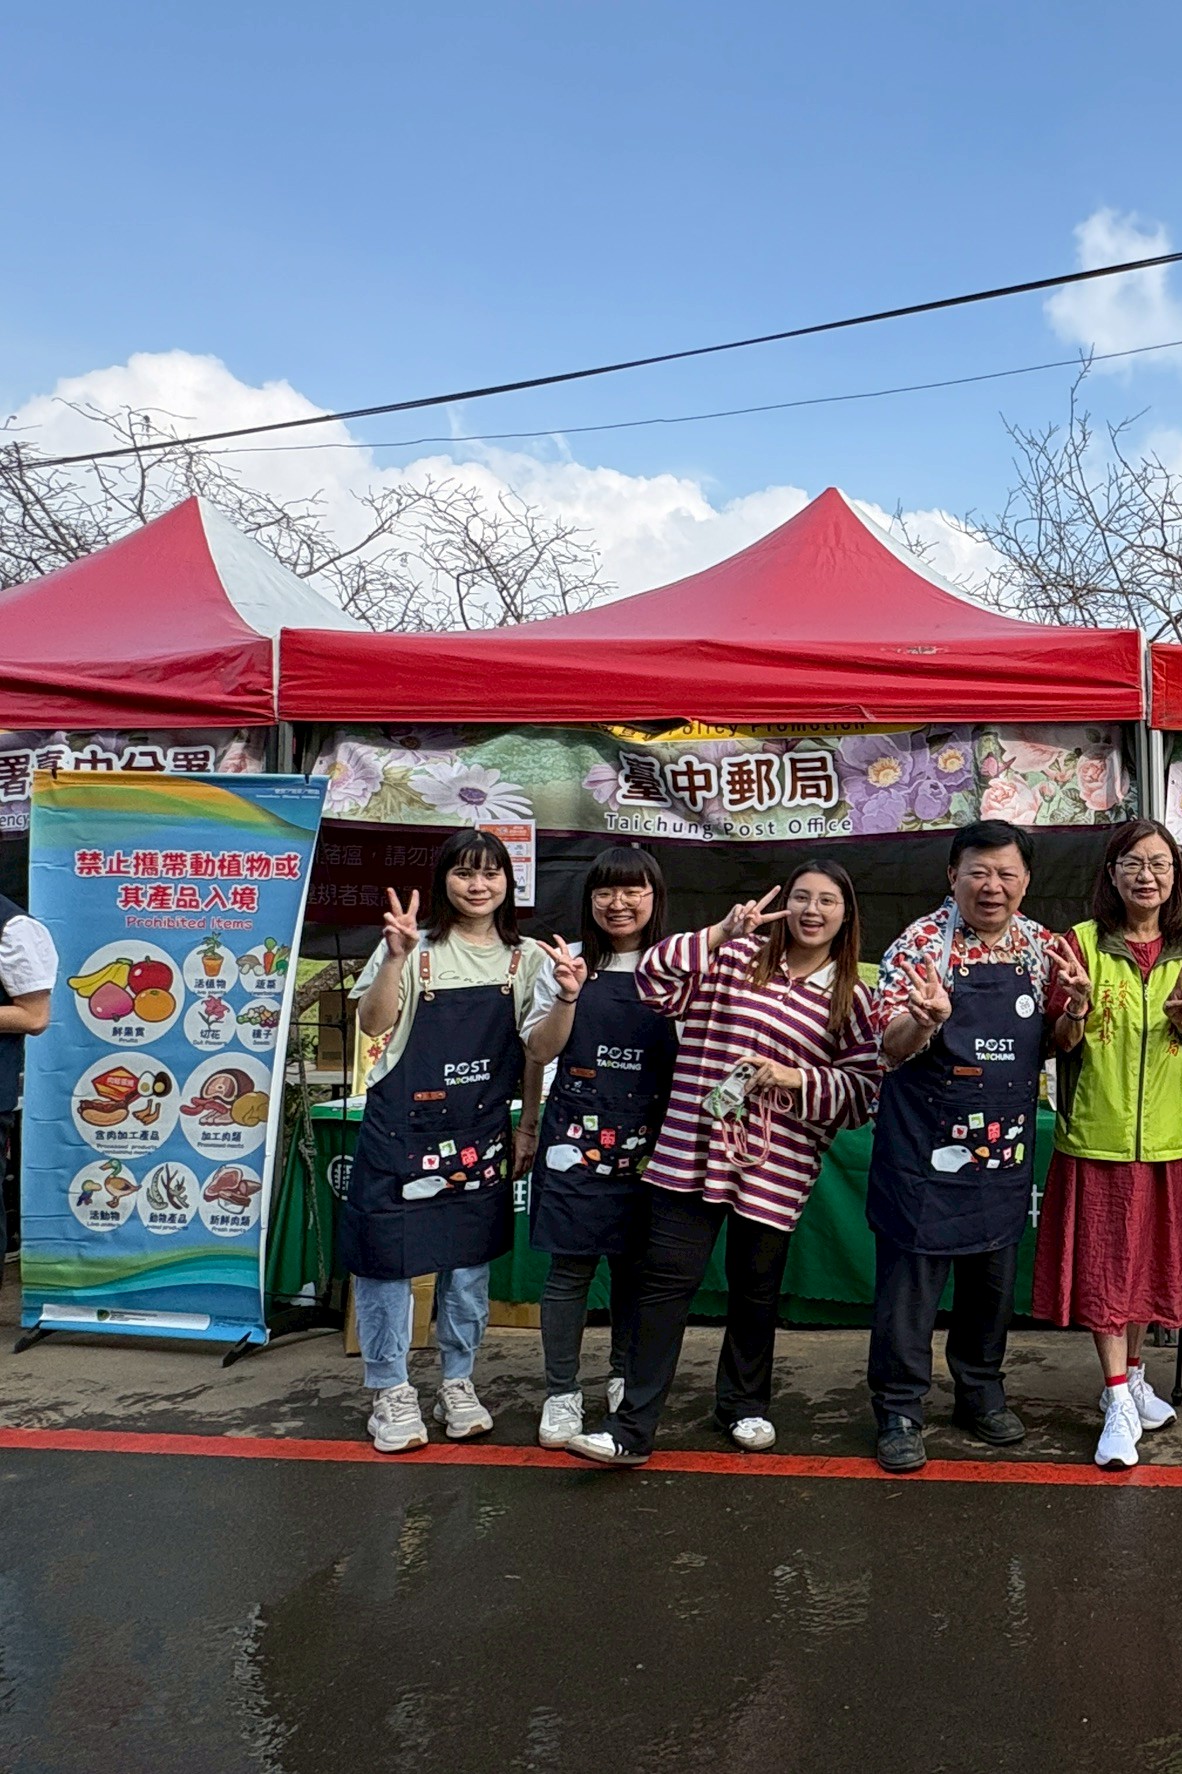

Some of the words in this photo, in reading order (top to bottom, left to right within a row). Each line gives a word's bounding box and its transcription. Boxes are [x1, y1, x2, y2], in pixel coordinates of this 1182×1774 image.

[668, 719, 738, 738] olicy
[621, 753, 836, 808] 臺中郵局
[605, 813, 714, 840] Taichung
[724, 821, 775, 837] Post
[788, 817, 852, 837] Office
[76, 850, 301, 879] 禁止攜帶動植物或
[118, 884, 258, 911] 其產品入境
[126, 916, 206, 930] Prohibited
[211, 917, 253, 931] Items
[200, 1029, 221, 1040] 切花
[975, 1038, 1015, 1052] POST
[596, 1045, 644, 1061] POST
[444, 1059, 491, 1076] POST
[94, 1130, 160, 1142] 含肉加工產品
[89, 1210, 120, 1221] 活動物
[149, 1212, 188, 1224] 動物產品
[209, 1214, 251, 1226] 新鮮肉類
